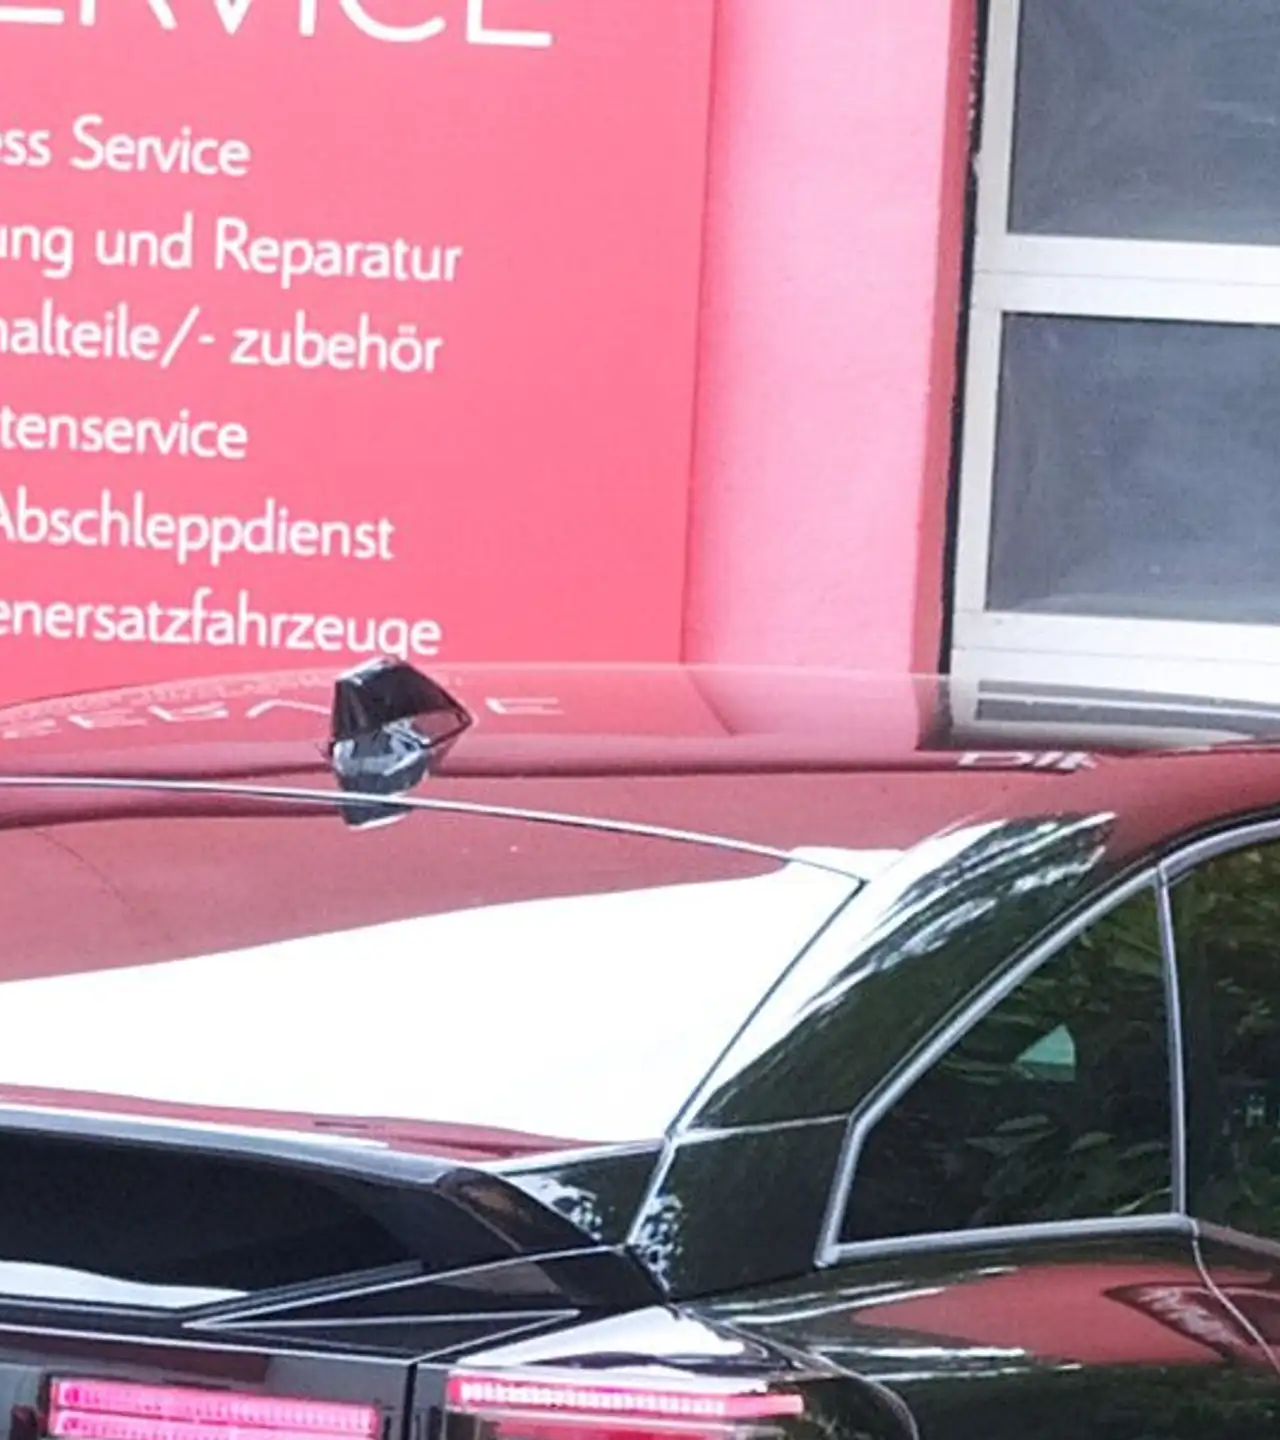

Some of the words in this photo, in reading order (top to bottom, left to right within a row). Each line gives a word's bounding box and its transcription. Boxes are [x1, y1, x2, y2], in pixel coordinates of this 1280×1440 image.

[71, 114, 251, 177] Service
[95, 211, 194, 270] und
[214, 216, 463, 290] Reparatur
[230, 309, 444, 374] zubehör
